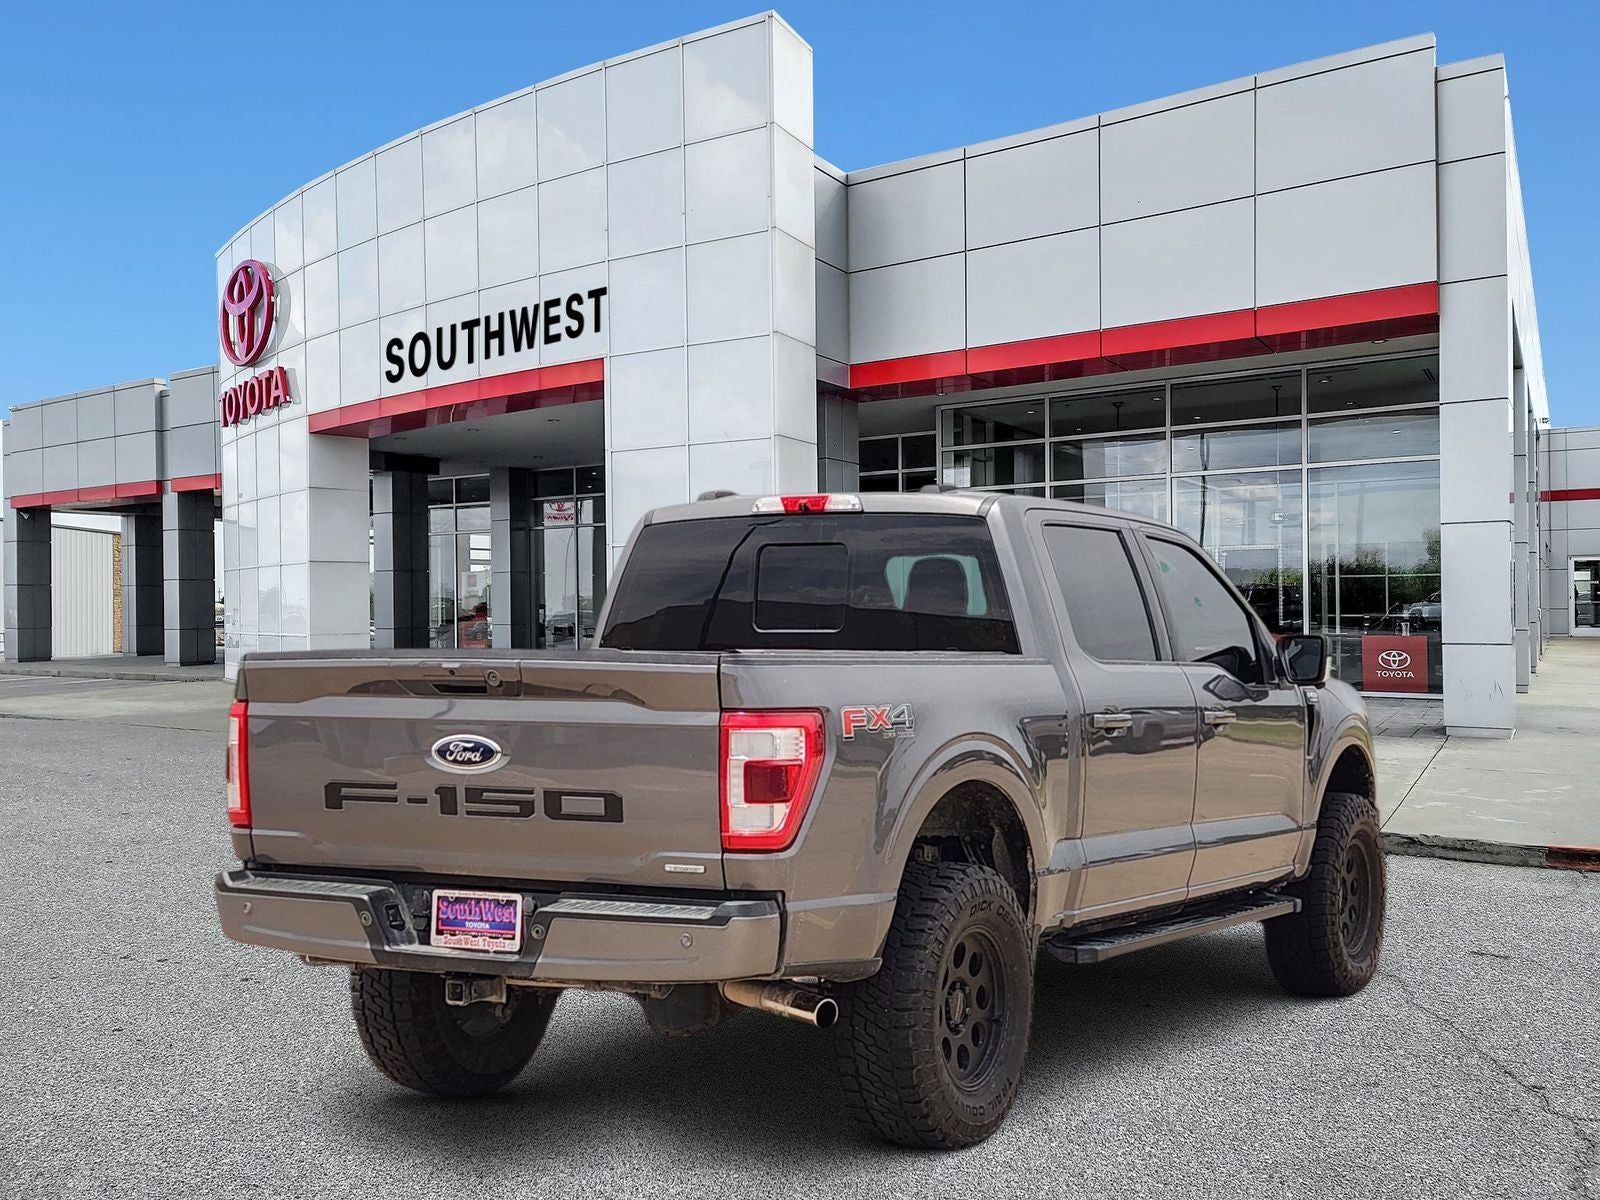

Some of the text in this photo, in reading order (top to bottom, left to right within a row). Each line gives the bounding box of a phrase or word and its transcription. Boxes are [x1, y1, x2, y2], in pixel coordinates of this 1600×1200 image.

[385, 286, 607, 384] SOUTHWEST
[219, 366, 290, 428] TOYOTA
[1376, 670, 1414, 678] TOYOTA
[841, 703, 915, 741] FX4
[446, 741, 483, 762] Ford
[324, 779, 624, 823] F-150
[465, 921, 490, 930] TOYOTA
[482, 938, 506, 950] Toyota
